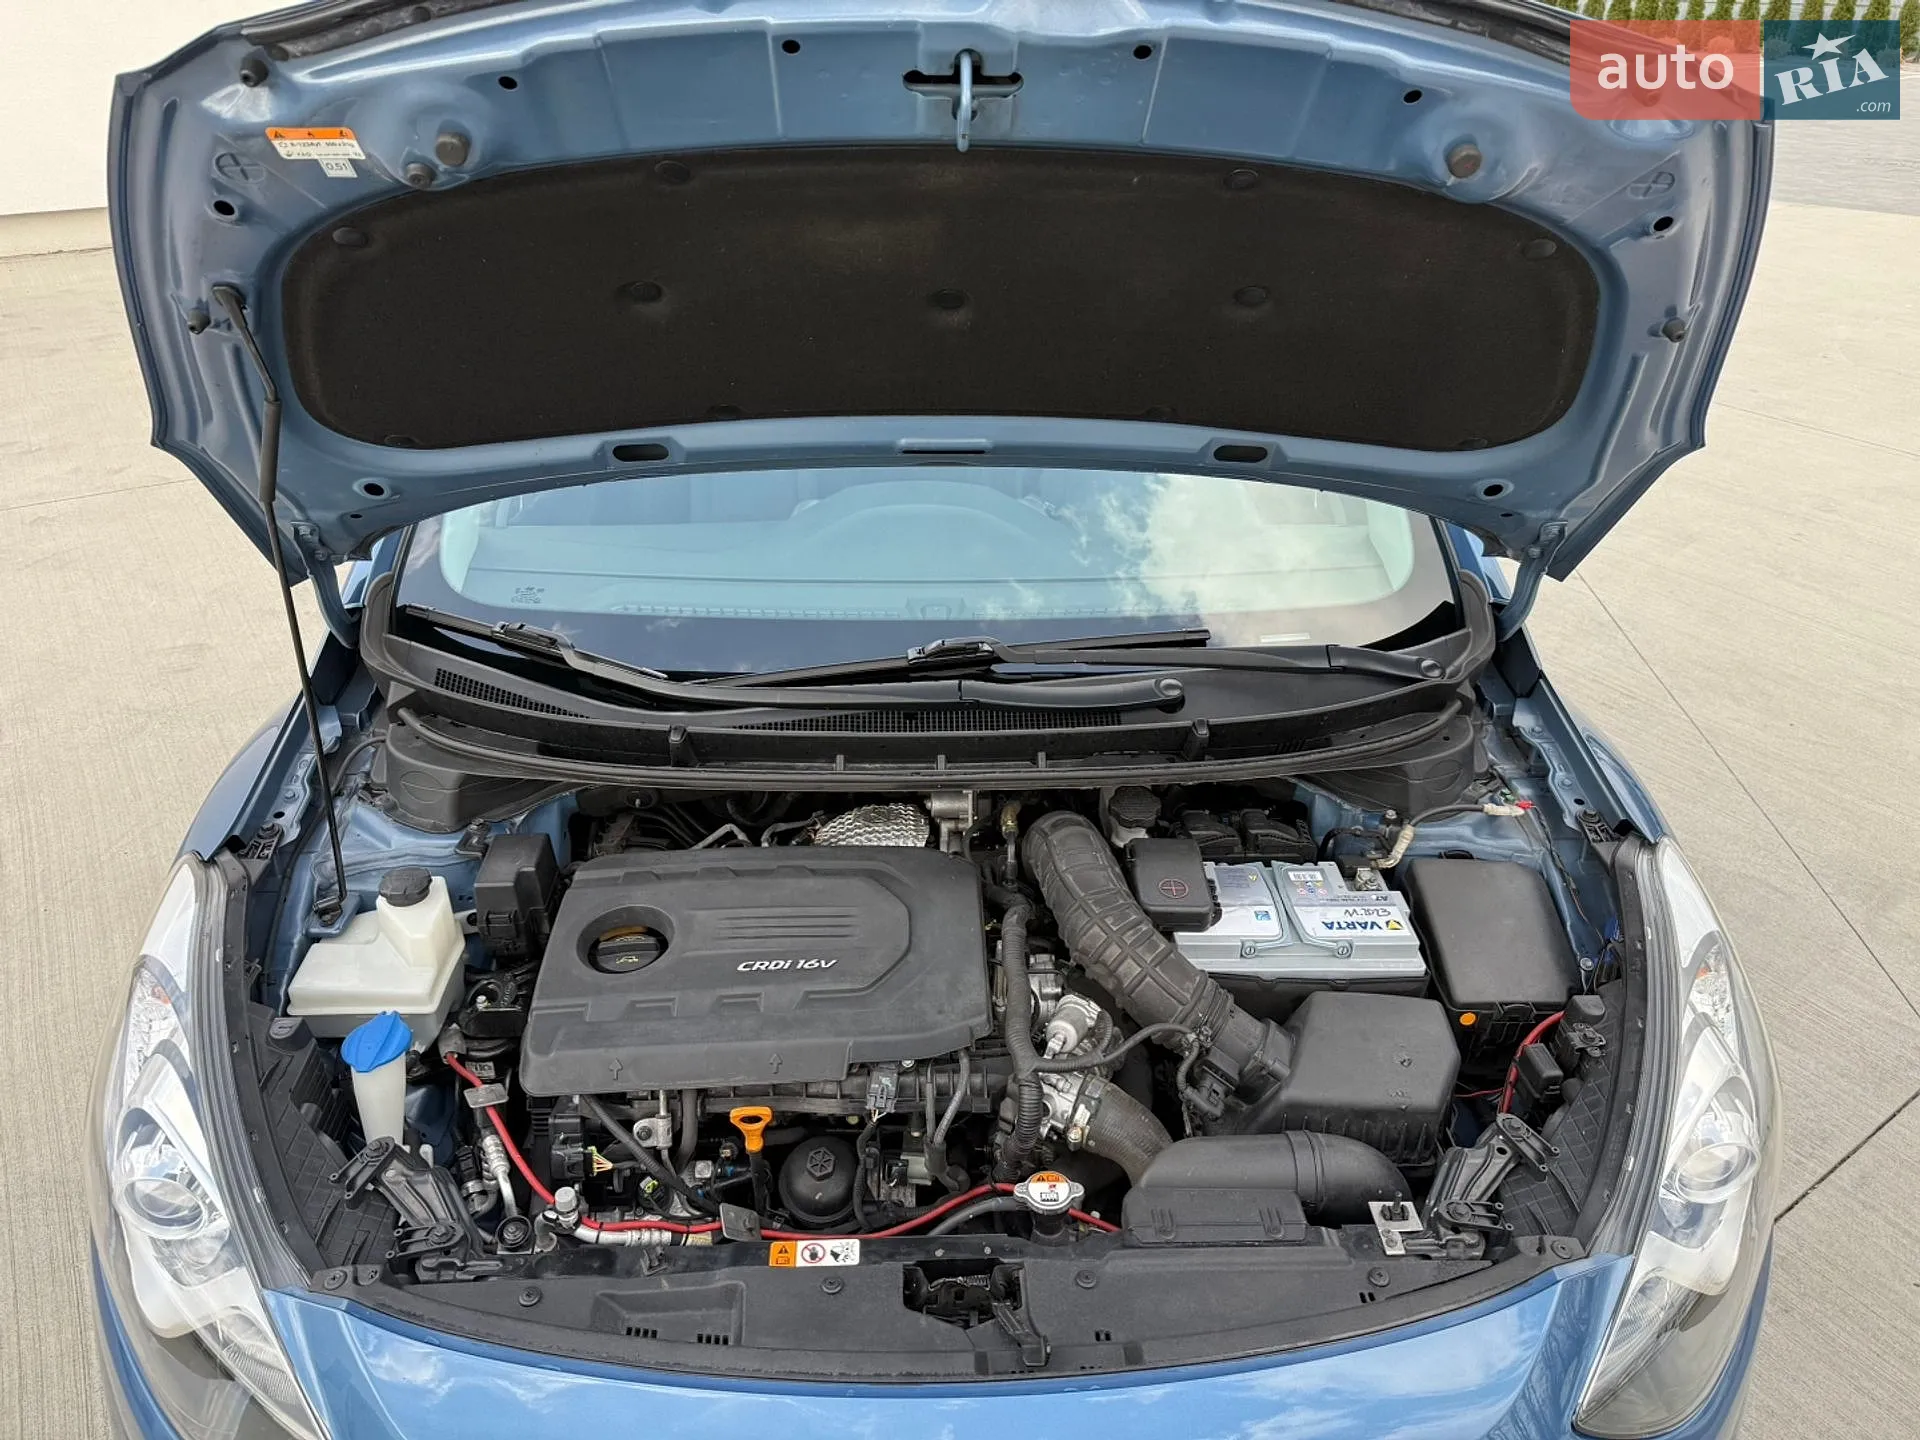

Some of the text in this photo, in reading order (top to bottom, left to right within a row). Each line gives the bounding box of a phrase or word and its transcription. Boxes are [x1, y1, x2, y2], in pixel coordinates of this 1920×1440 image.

[1321, 920, 1384, 930] VARTA
[736, 959, 838, 971] CRDi 16V
